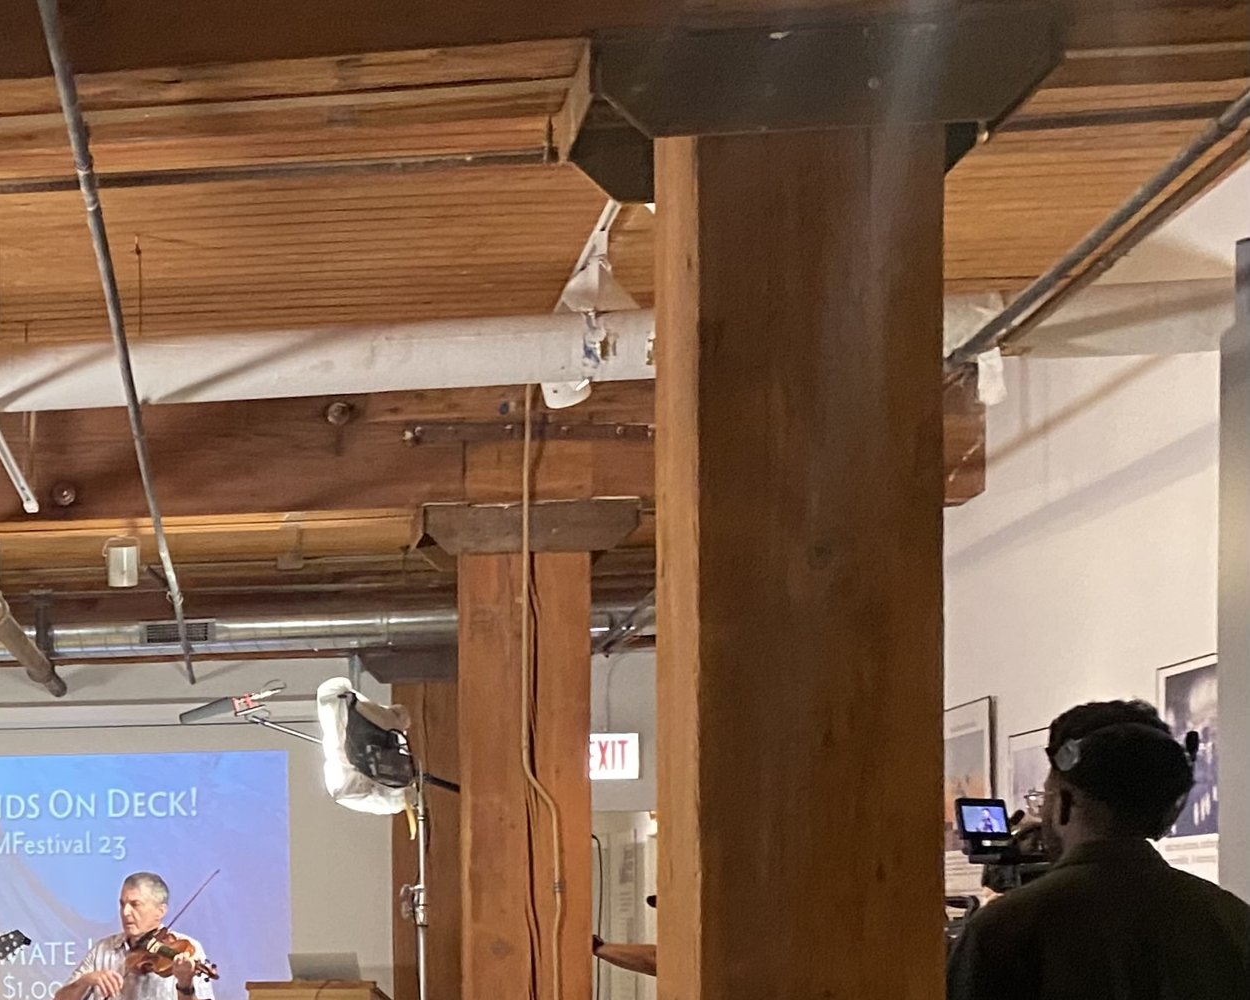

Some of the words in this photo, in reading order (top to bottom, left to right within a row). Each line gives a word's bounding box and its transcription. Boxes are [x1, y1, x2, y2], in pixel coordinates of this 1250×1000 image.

[48, 788, 97, 819] ON
[106, 786, 198, 819] DECK!
[98, 835, 127, 860] 23
